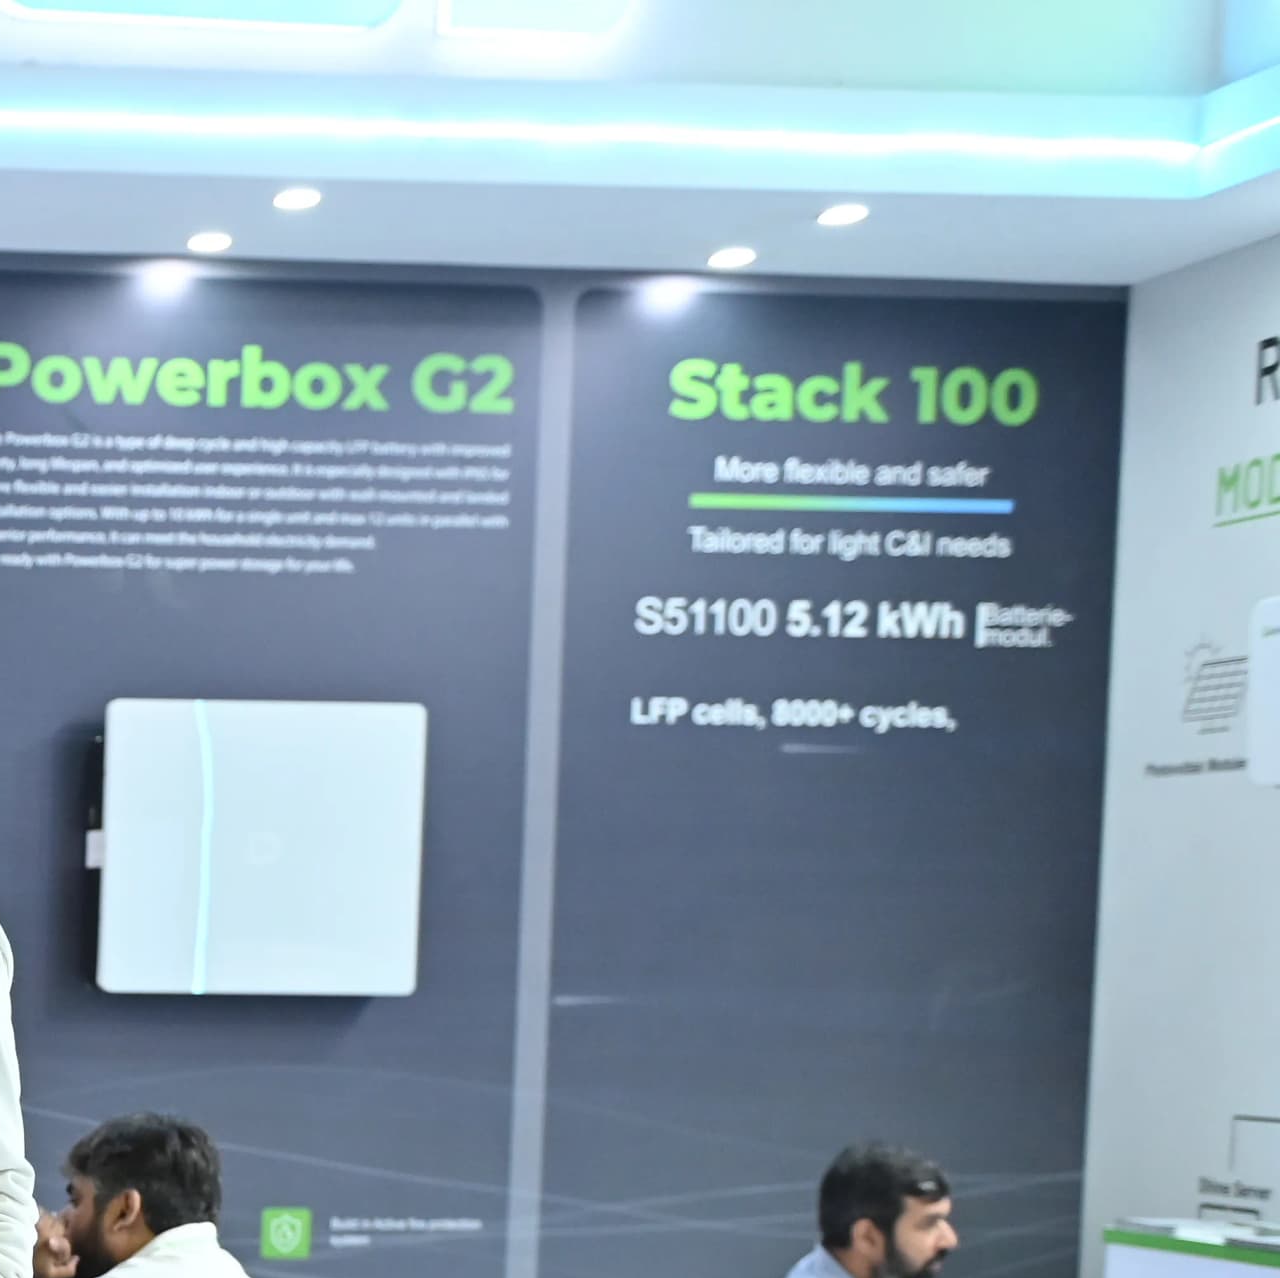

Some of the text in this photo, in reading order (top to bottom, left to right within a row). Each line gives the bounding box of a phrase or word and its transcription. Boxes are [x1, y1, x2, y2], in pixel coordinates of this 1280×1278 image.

[412, 353, 515, 414] G2
[666, 355, 1037, 426] Stack 100
[714, 456, 989, 487] More flexible and safer
[687, 526, 785, 554] Tailored
[789, 528, 824, 554] for
[828, 530, 881, 561] light
[936, 534, 1011, 558] needs
[634, 596, 965, 638] S51100 5.12 kWh
[631, 697, 956, 733] LFP cells, 8000+ cycles,
